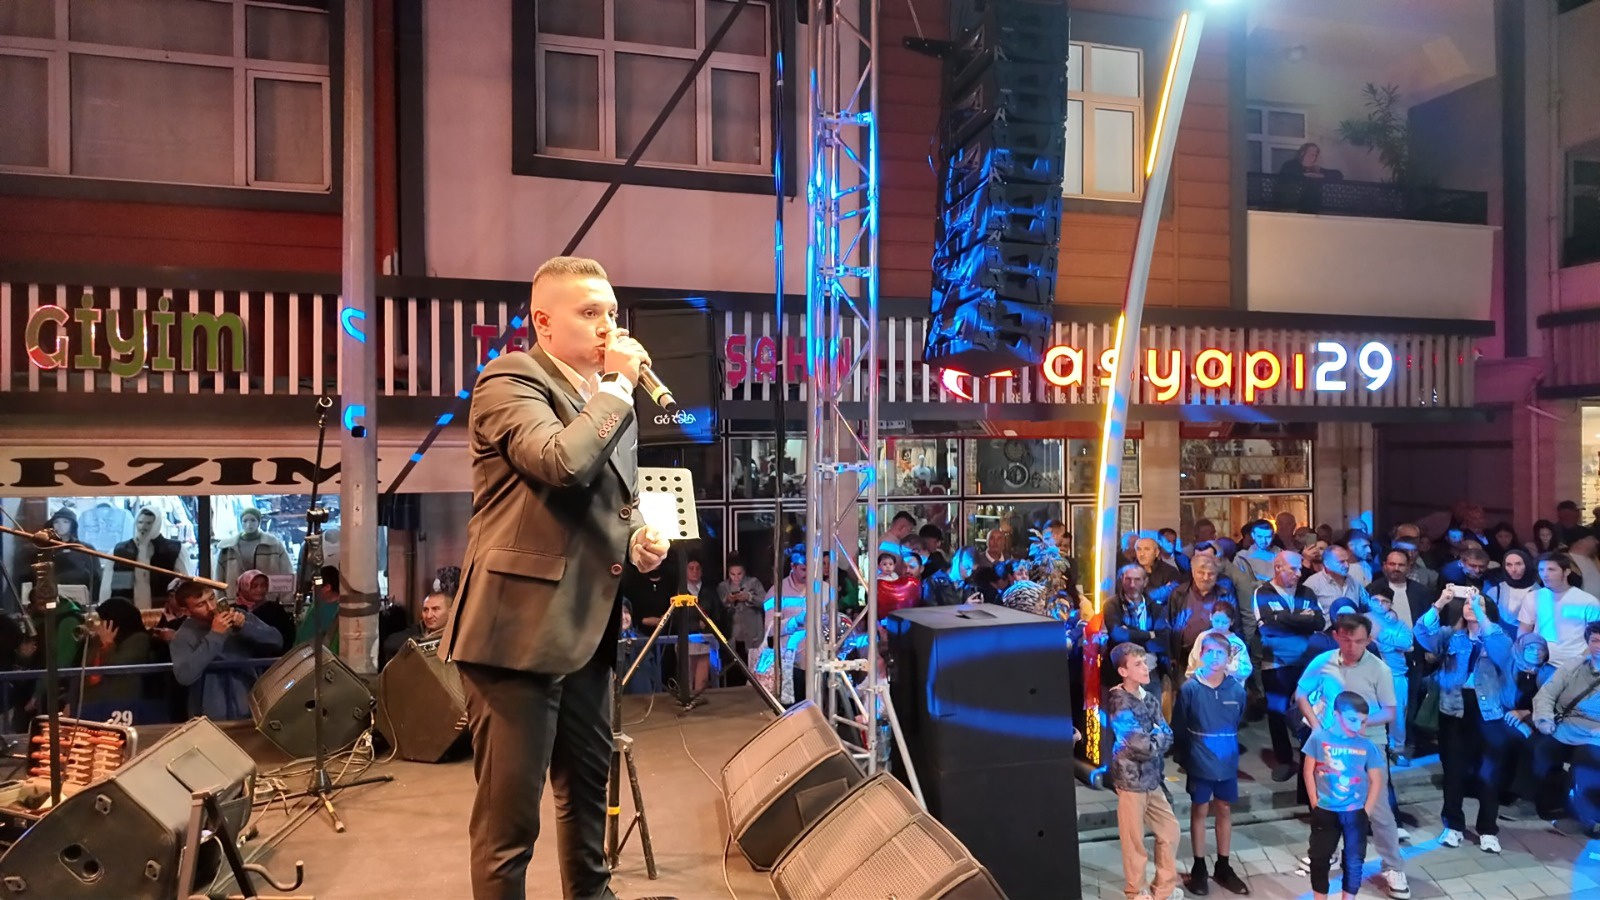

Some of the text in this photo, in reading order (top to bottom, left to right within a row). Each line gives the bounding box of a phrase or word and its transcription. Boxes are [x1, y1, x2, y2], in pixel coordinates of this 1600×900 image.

[25, 293, 247, 378] Giyim
[0, 456, 382, 488] RZIM
[111, 710, 133, 727] 29
